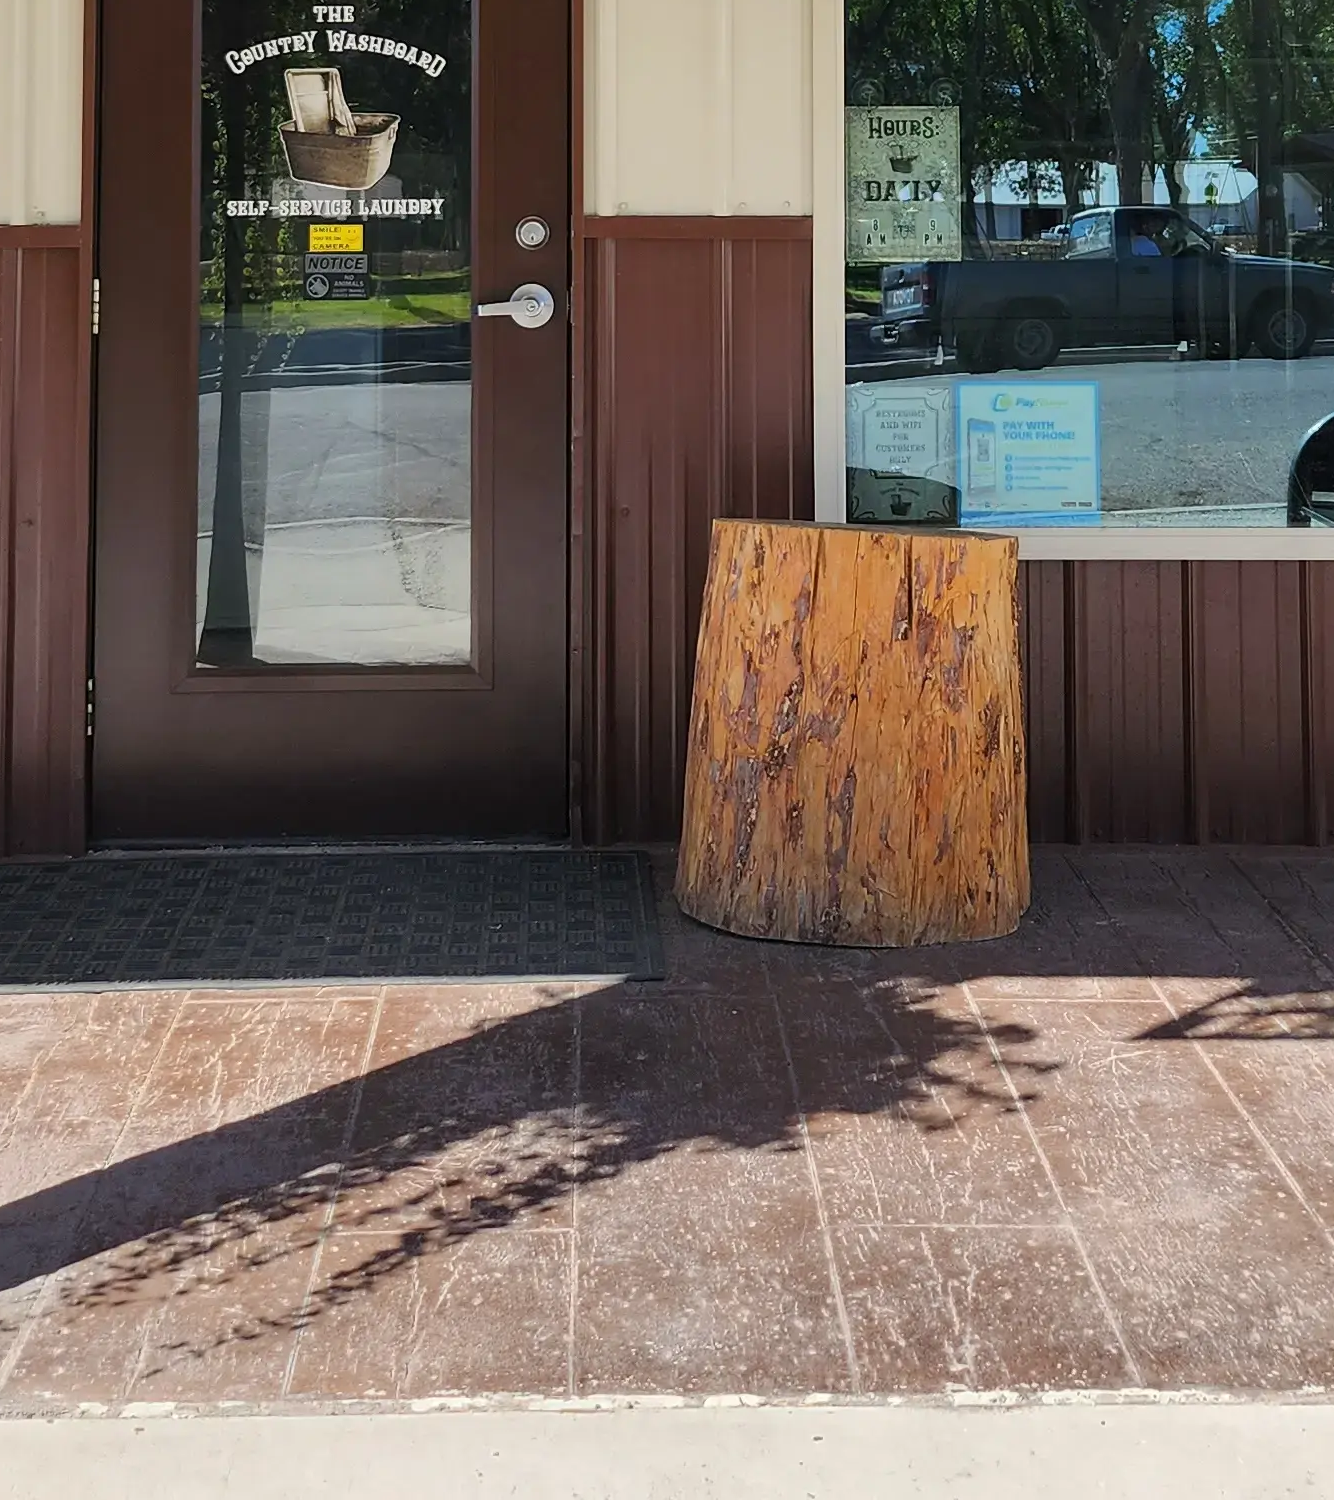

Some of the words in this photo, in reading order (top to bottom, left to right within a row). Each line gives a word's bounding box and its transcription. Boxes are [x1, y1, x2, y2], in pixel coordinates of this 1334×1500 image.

[313, 5, 355, 23] THE
[225, 30, 317, 76] COUNTRY
[327, 29, 447, 79] WASHBOARD
[868, 116, 940, 139] HOURS:
[227, 199, 352, 218] SELF-SERVICE
[358, 199, 445, 218] LAUNDRY
[872, 219, 879, 231] 8
[930, 219, 936, 231] 9
[308, 257, 365, 270] NOTICE
[1025, 421, 1055, 430] WITH
